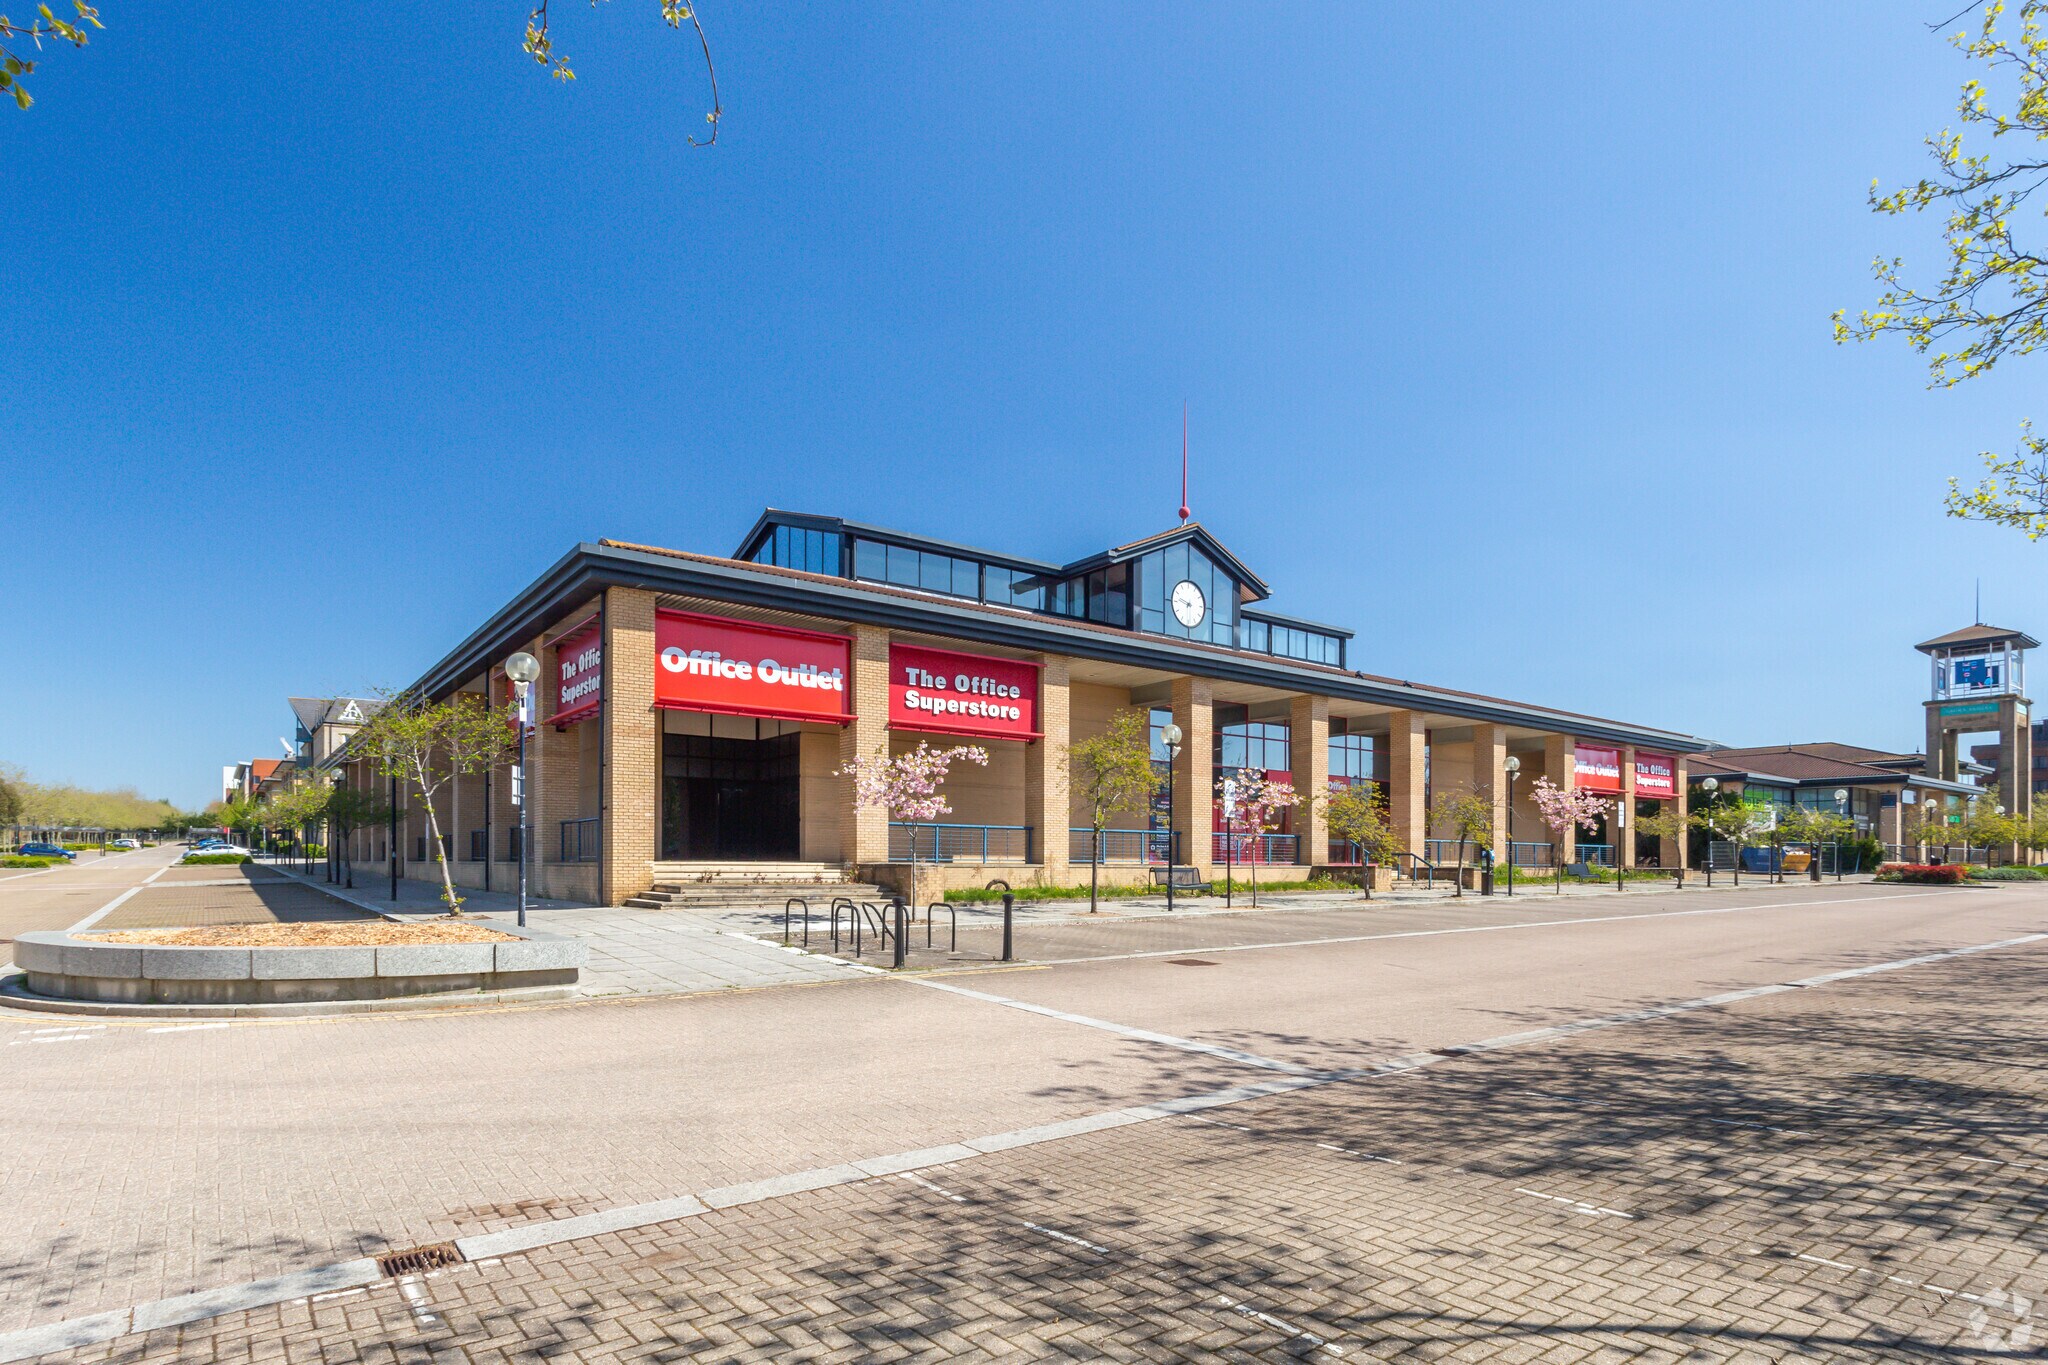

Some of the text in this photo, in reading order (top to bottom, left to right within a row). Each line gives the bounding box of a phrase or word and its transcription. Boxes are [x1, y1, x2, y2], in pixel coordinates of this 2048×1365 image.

[562, 647, 600, 680] The Offic
[661, 646, 843, 691] Office Outlet
[561, 674, 600, 704] Superstor
[904, 667, 1021, 699] The Office
[904, 690, 1021, 722] Superstore
[1636, 763, 1671, 776] The Office
[1636, 775, 1670, 788] Superstore
